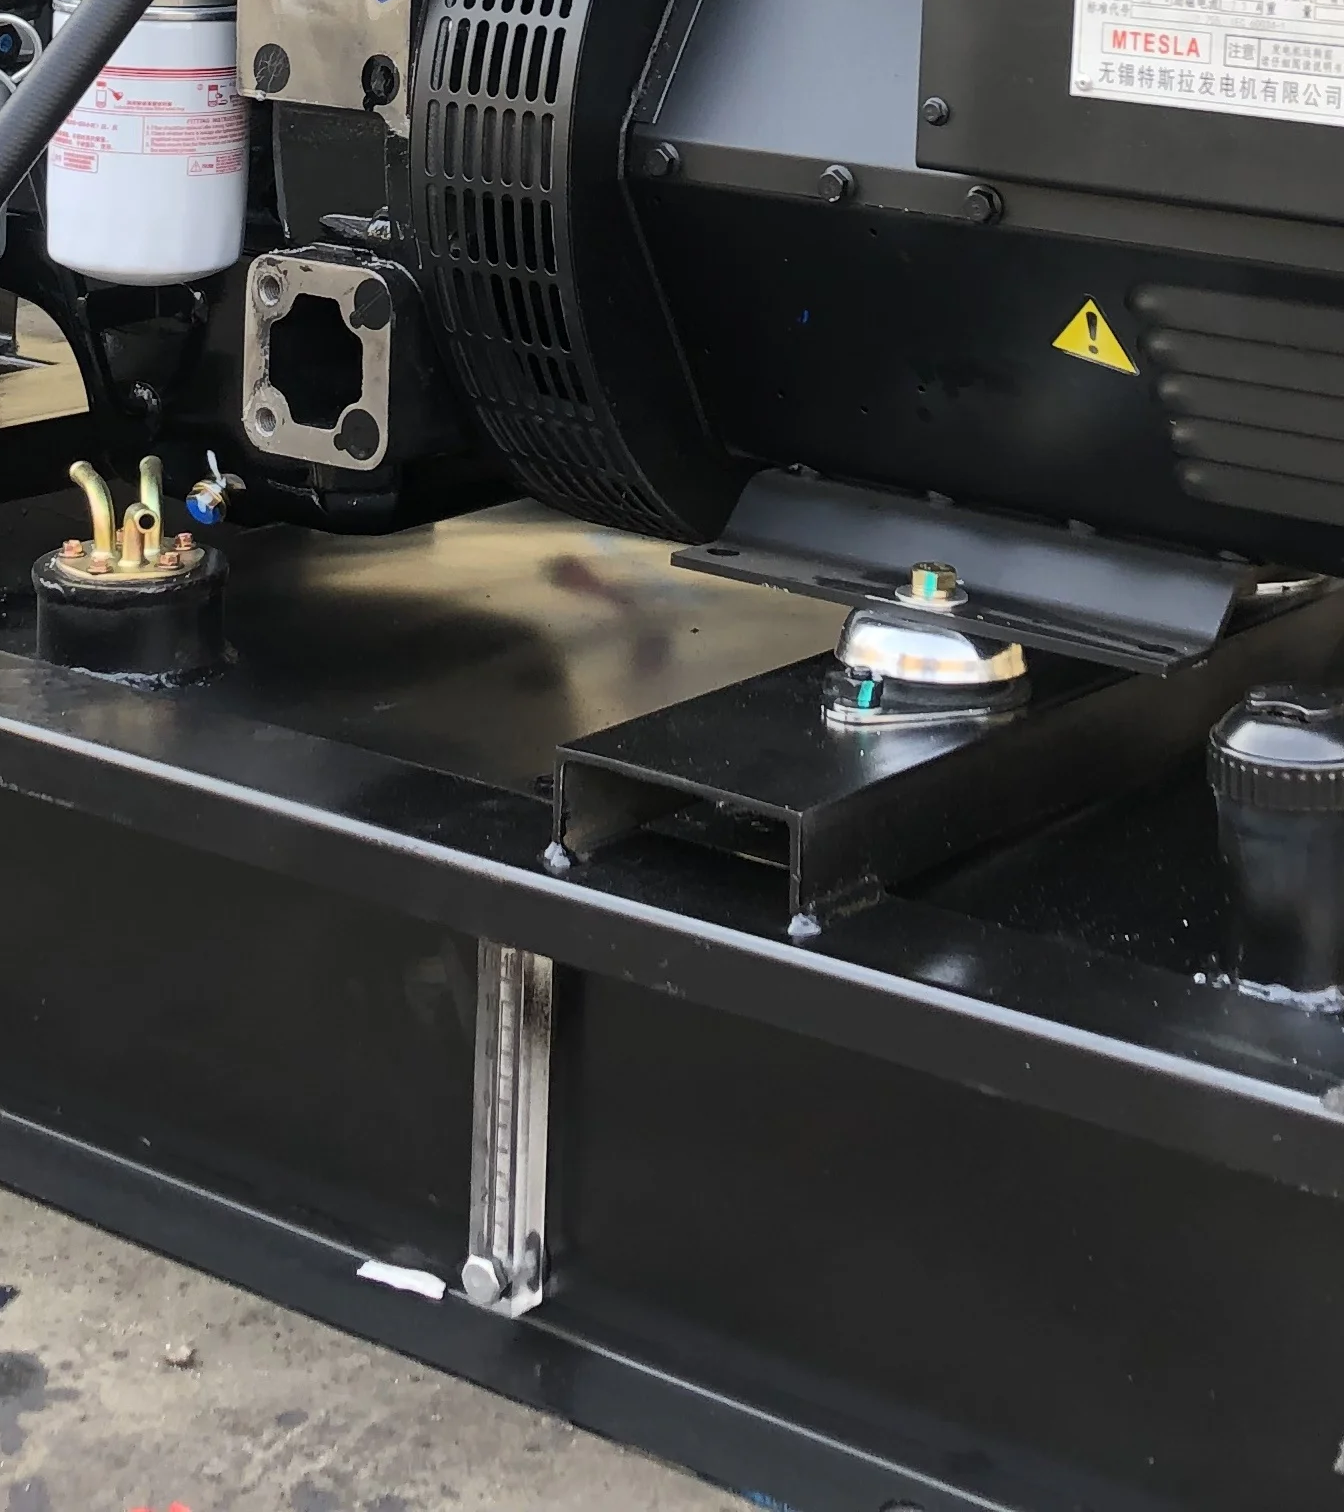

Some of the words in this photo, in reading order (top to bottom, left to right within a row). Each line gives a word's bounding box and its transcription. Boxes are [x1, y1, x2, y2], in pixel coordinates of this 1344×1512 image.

[1111, 29, 1201, 57] MTESLA
[1227, 42, 1256, 60] 注意
[1098, 61, 1343, 109] 无锡特斯拉发电机有限公司
